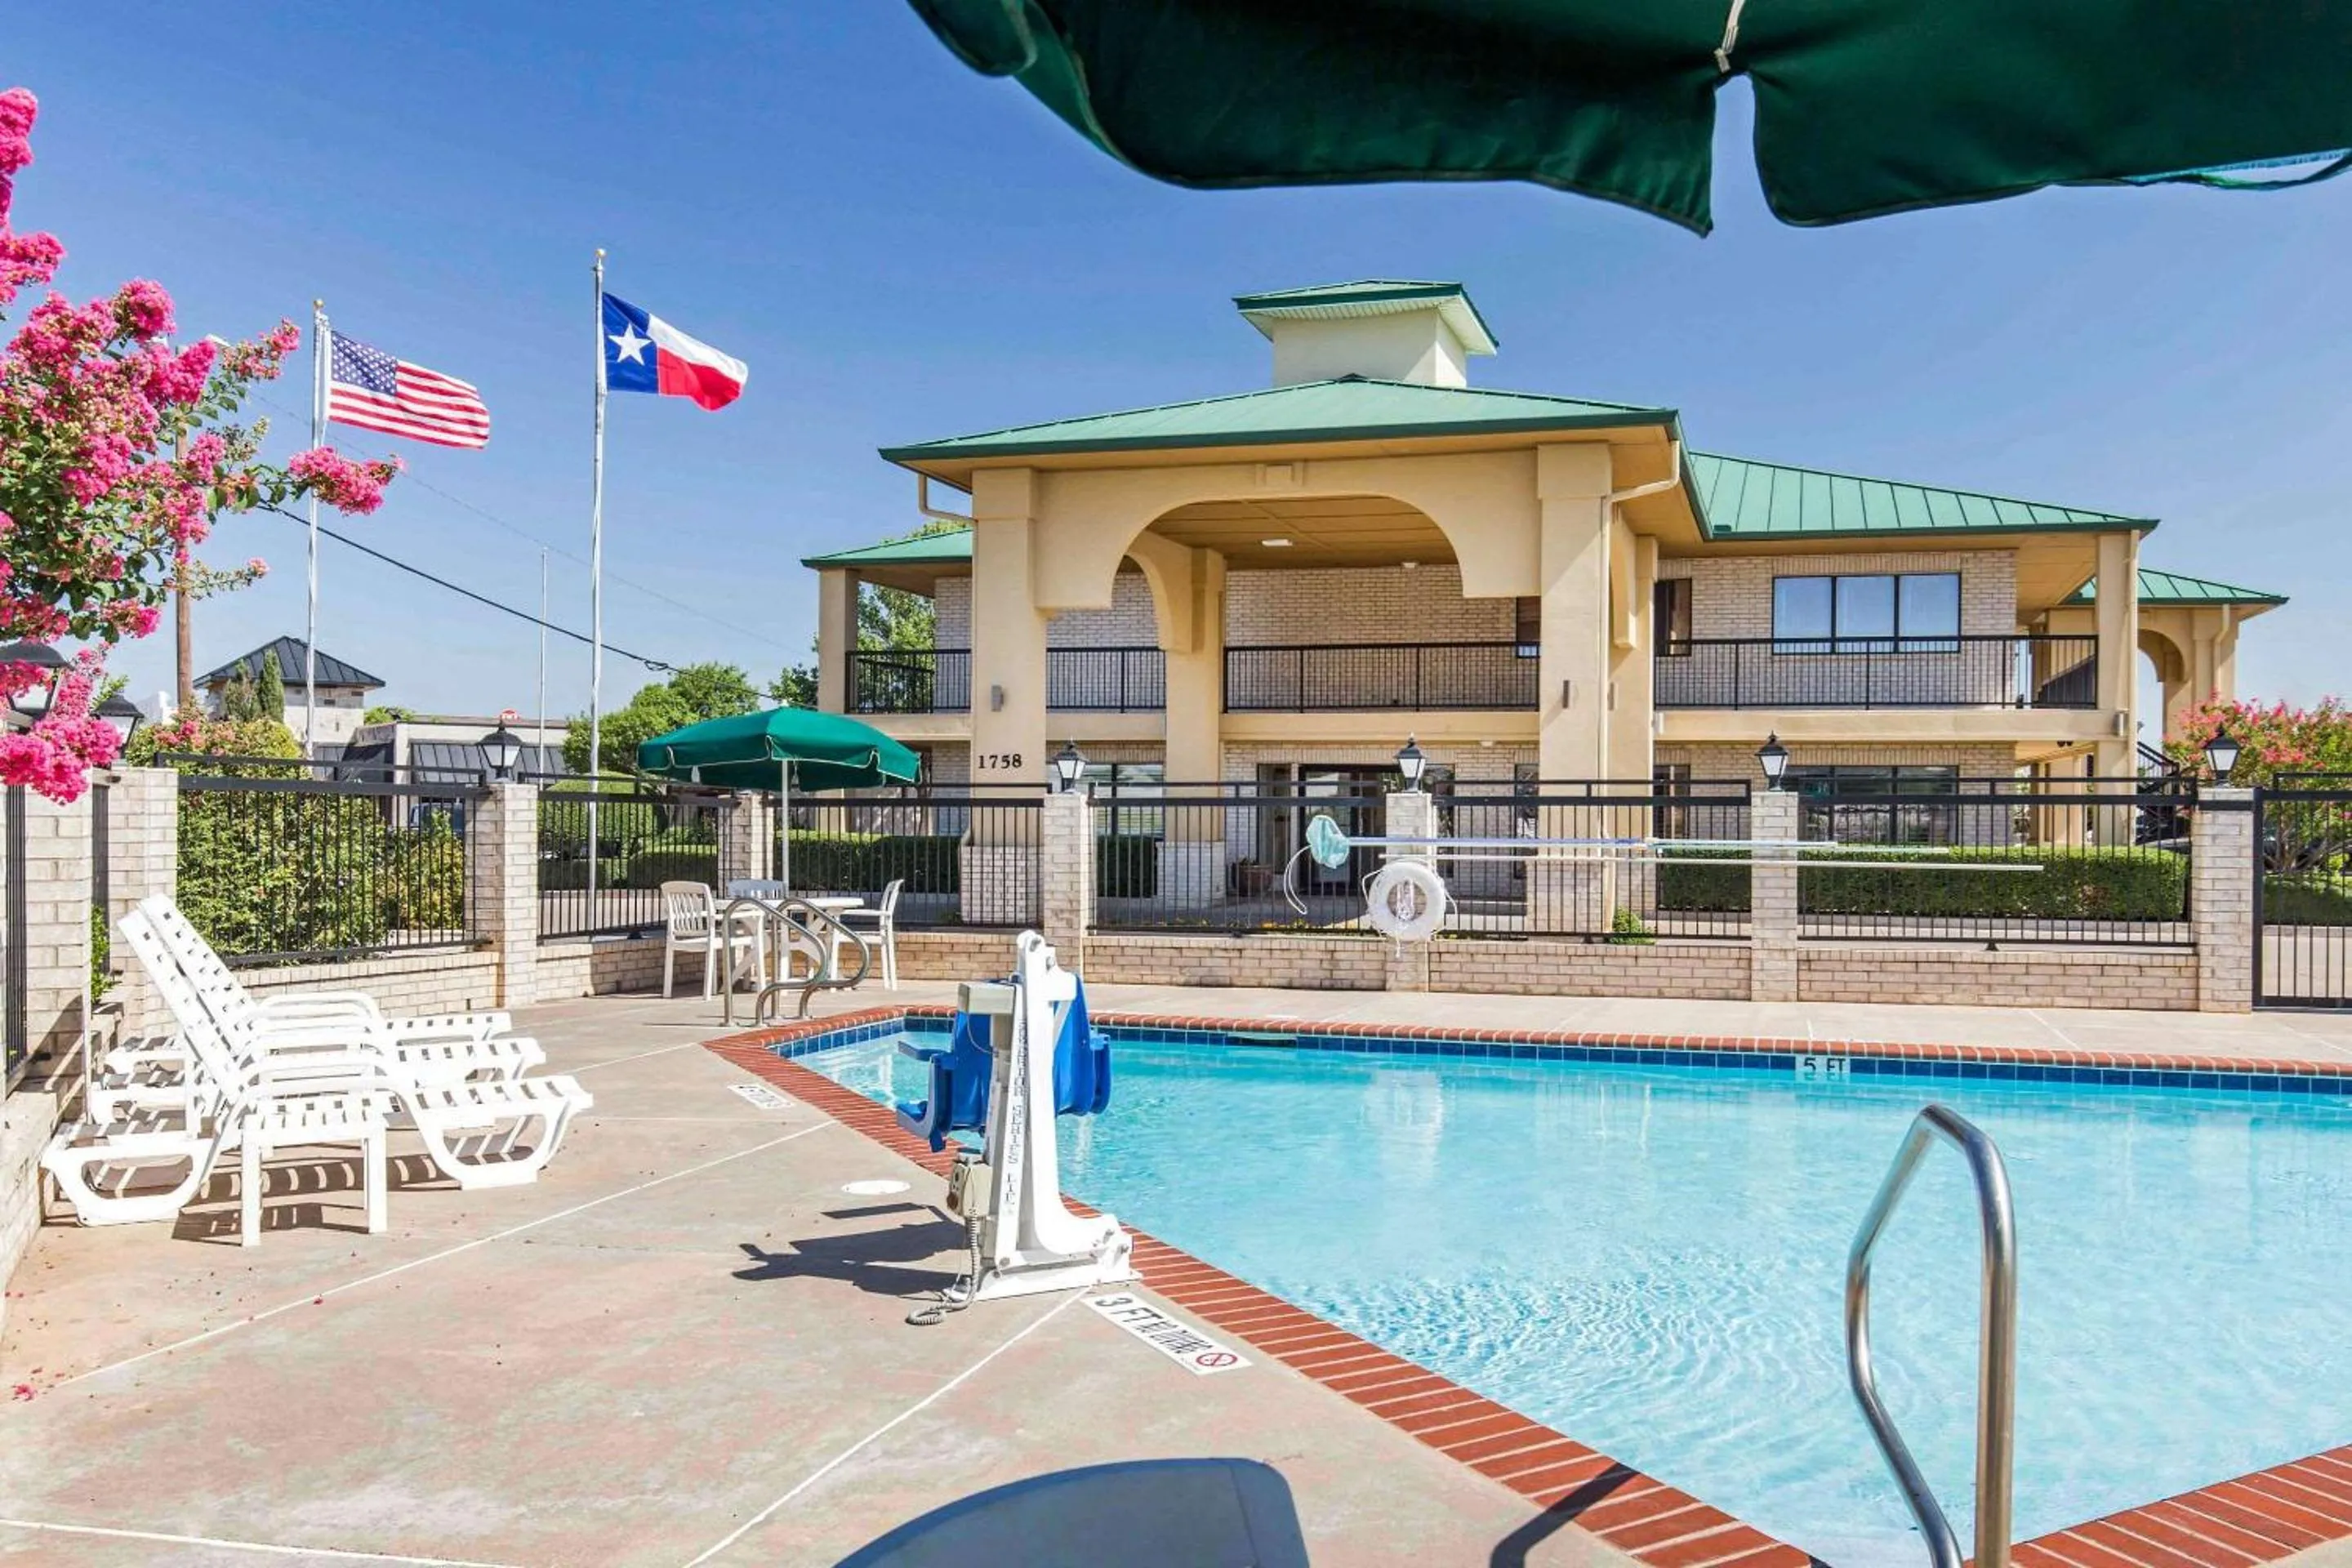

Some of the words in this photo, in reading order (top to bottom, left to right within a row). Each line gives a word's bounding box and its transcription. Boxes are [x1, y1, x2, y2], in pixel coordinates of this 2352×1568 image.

[978, 754, 1022, 768] 1758
[1803, 1057, 1817, 1072] 5
[1826, 1058, 1846, 1073] FT
[1094, 1297, 1134, 1307] 3
[1111, 1307, 1163, 1323] FT
